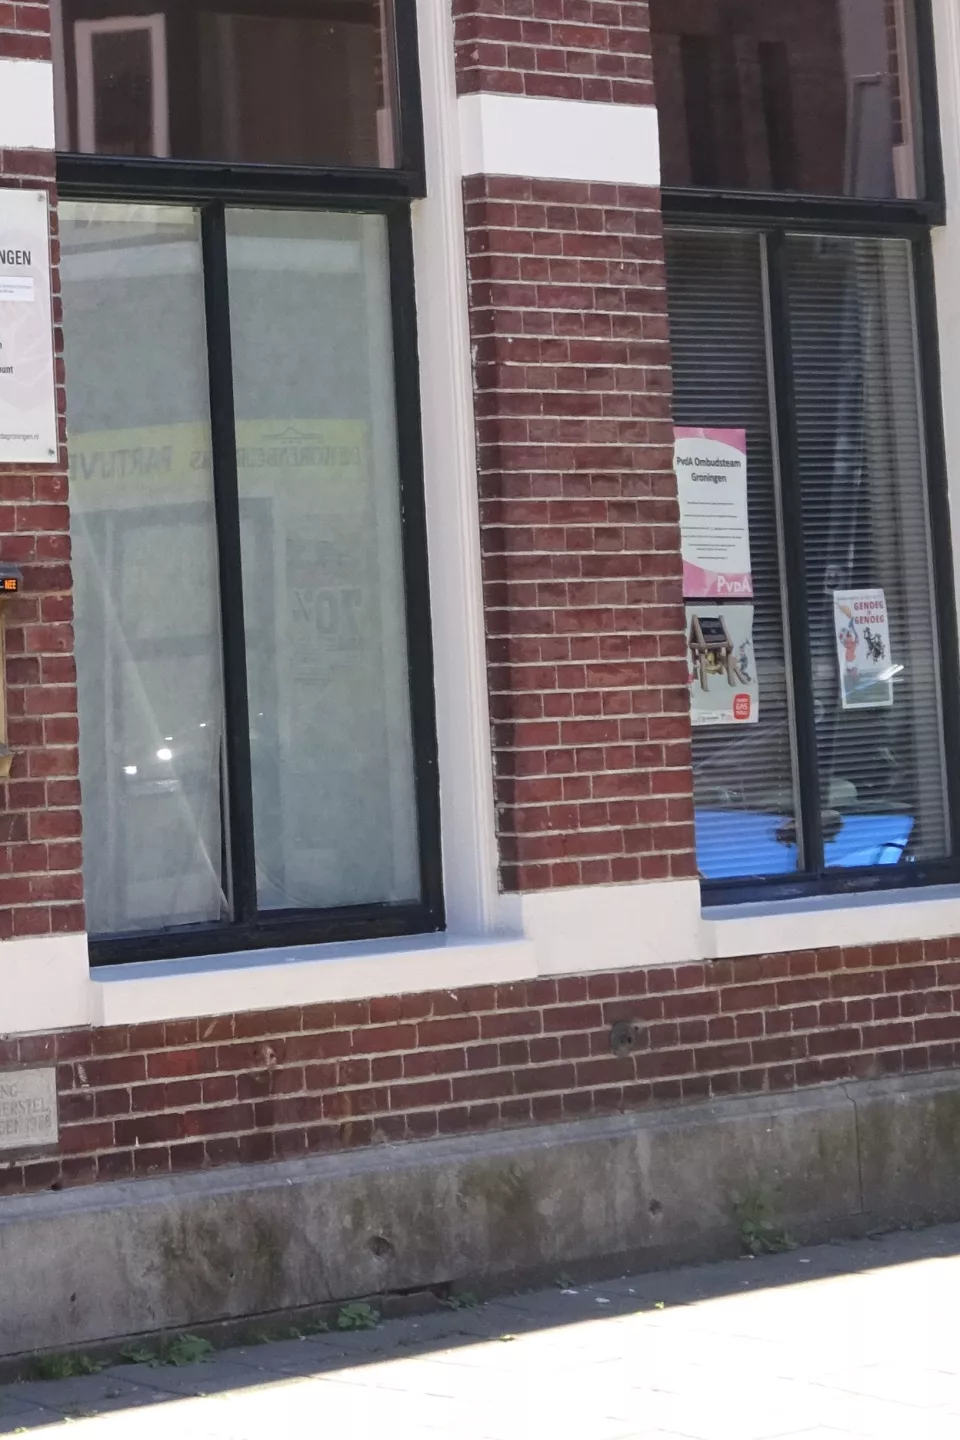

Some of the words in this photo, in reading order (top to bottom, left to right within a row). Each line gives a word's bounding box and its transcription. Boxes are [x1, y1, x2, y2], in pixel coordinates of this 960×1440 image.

[676, 456, 693, 467] PvdA
[694, 457, 741, 468] Ombudsteam
[691, 472, 727, 484] Groningen
[5, 580, 16, 589] NEE
[854, 601, 883, 610] GENOEG
[855, 615, 884, 624] GENOEG
